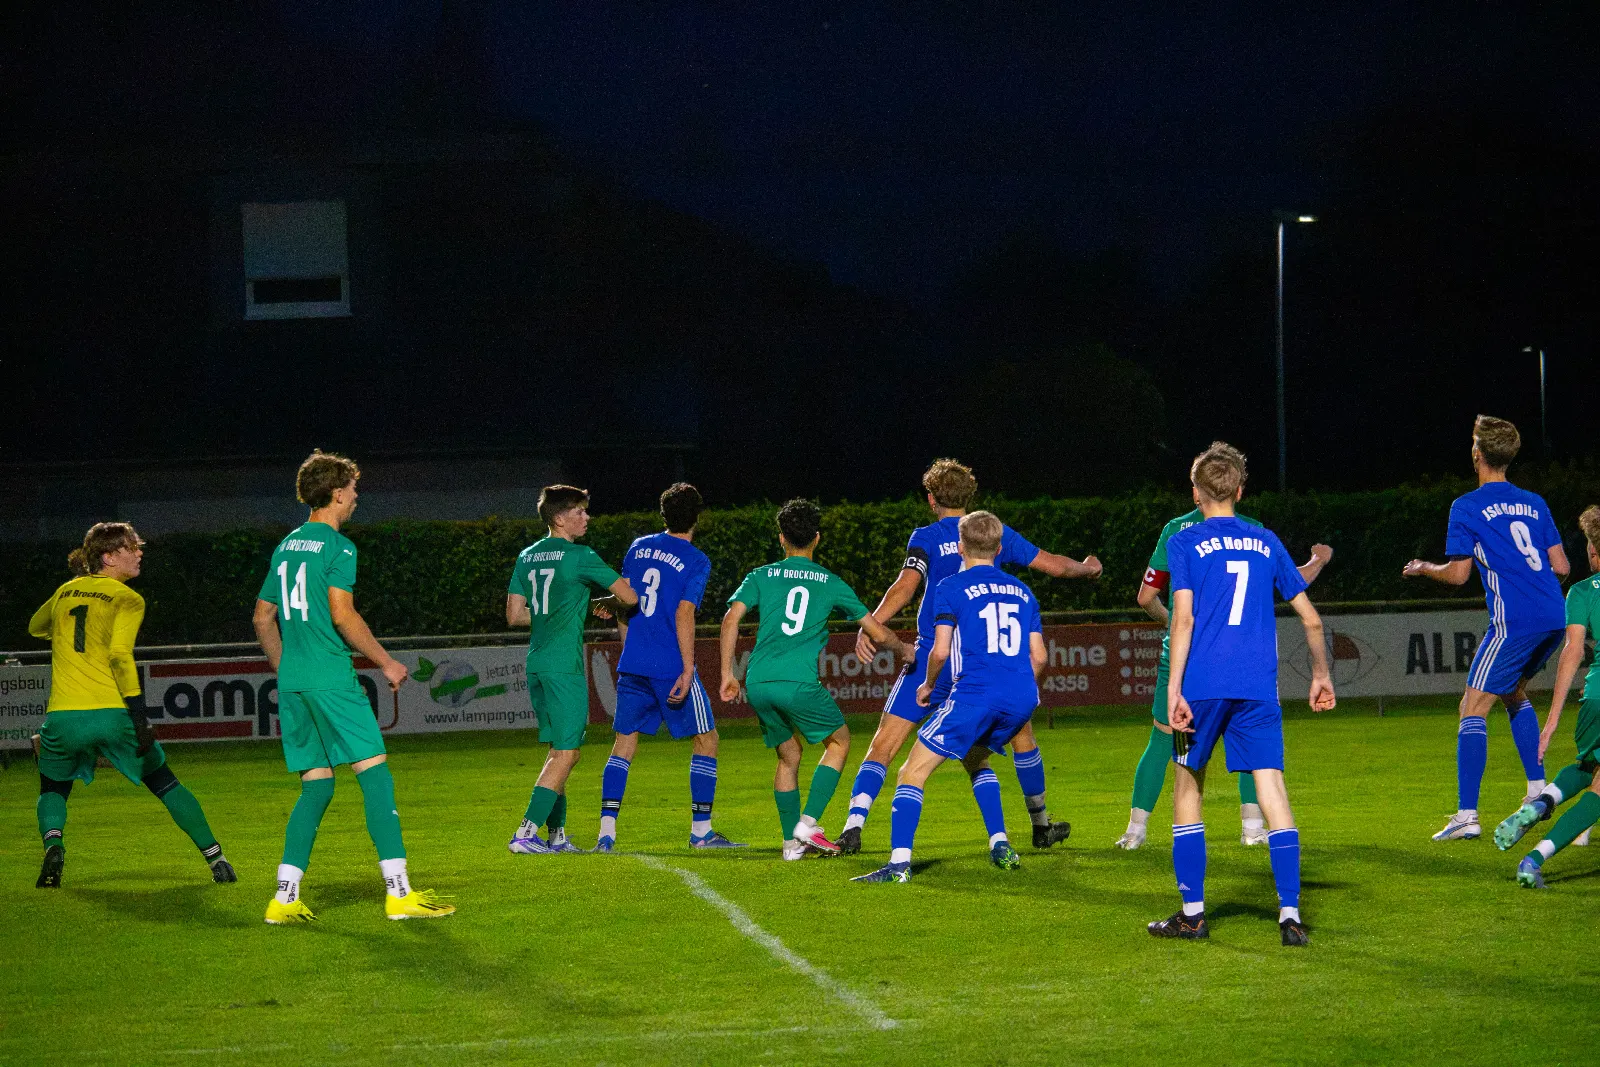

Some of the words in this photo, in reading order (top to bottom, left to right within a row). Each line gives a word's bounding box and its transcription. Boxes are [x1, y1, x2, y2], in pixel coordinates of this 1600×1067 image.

[653, 549, 685, 572] HoDiLa
[907, 556, 917, 567] C
[1223, 536, 1271, 558] HoDiLa
[1510, 520, 1543, 572] 9
[277, 560, 308, 621] 14
[767, 568, 780, 577] GW
[783, 568, 829, 583] BROCKDORF
[1144, 566, 1156, 582] C
[72, 589, 115, 603] Brockdorf
[528, 568, 555, 615] 17
[641, 567, 660, 617] 3
[989, 583, 1029, 604] HoDiLa
[1226, 560, 1249, 625] 7
[781, 586, 810, 636] 9
[69, 604, 89, 653] 1
[978, 602, 1022, 657] 15
[1406, 631, 1487, 676] ALB
[1, 676, 45, 695] gsbau
[1043, 674, 1089, 692] 4358
